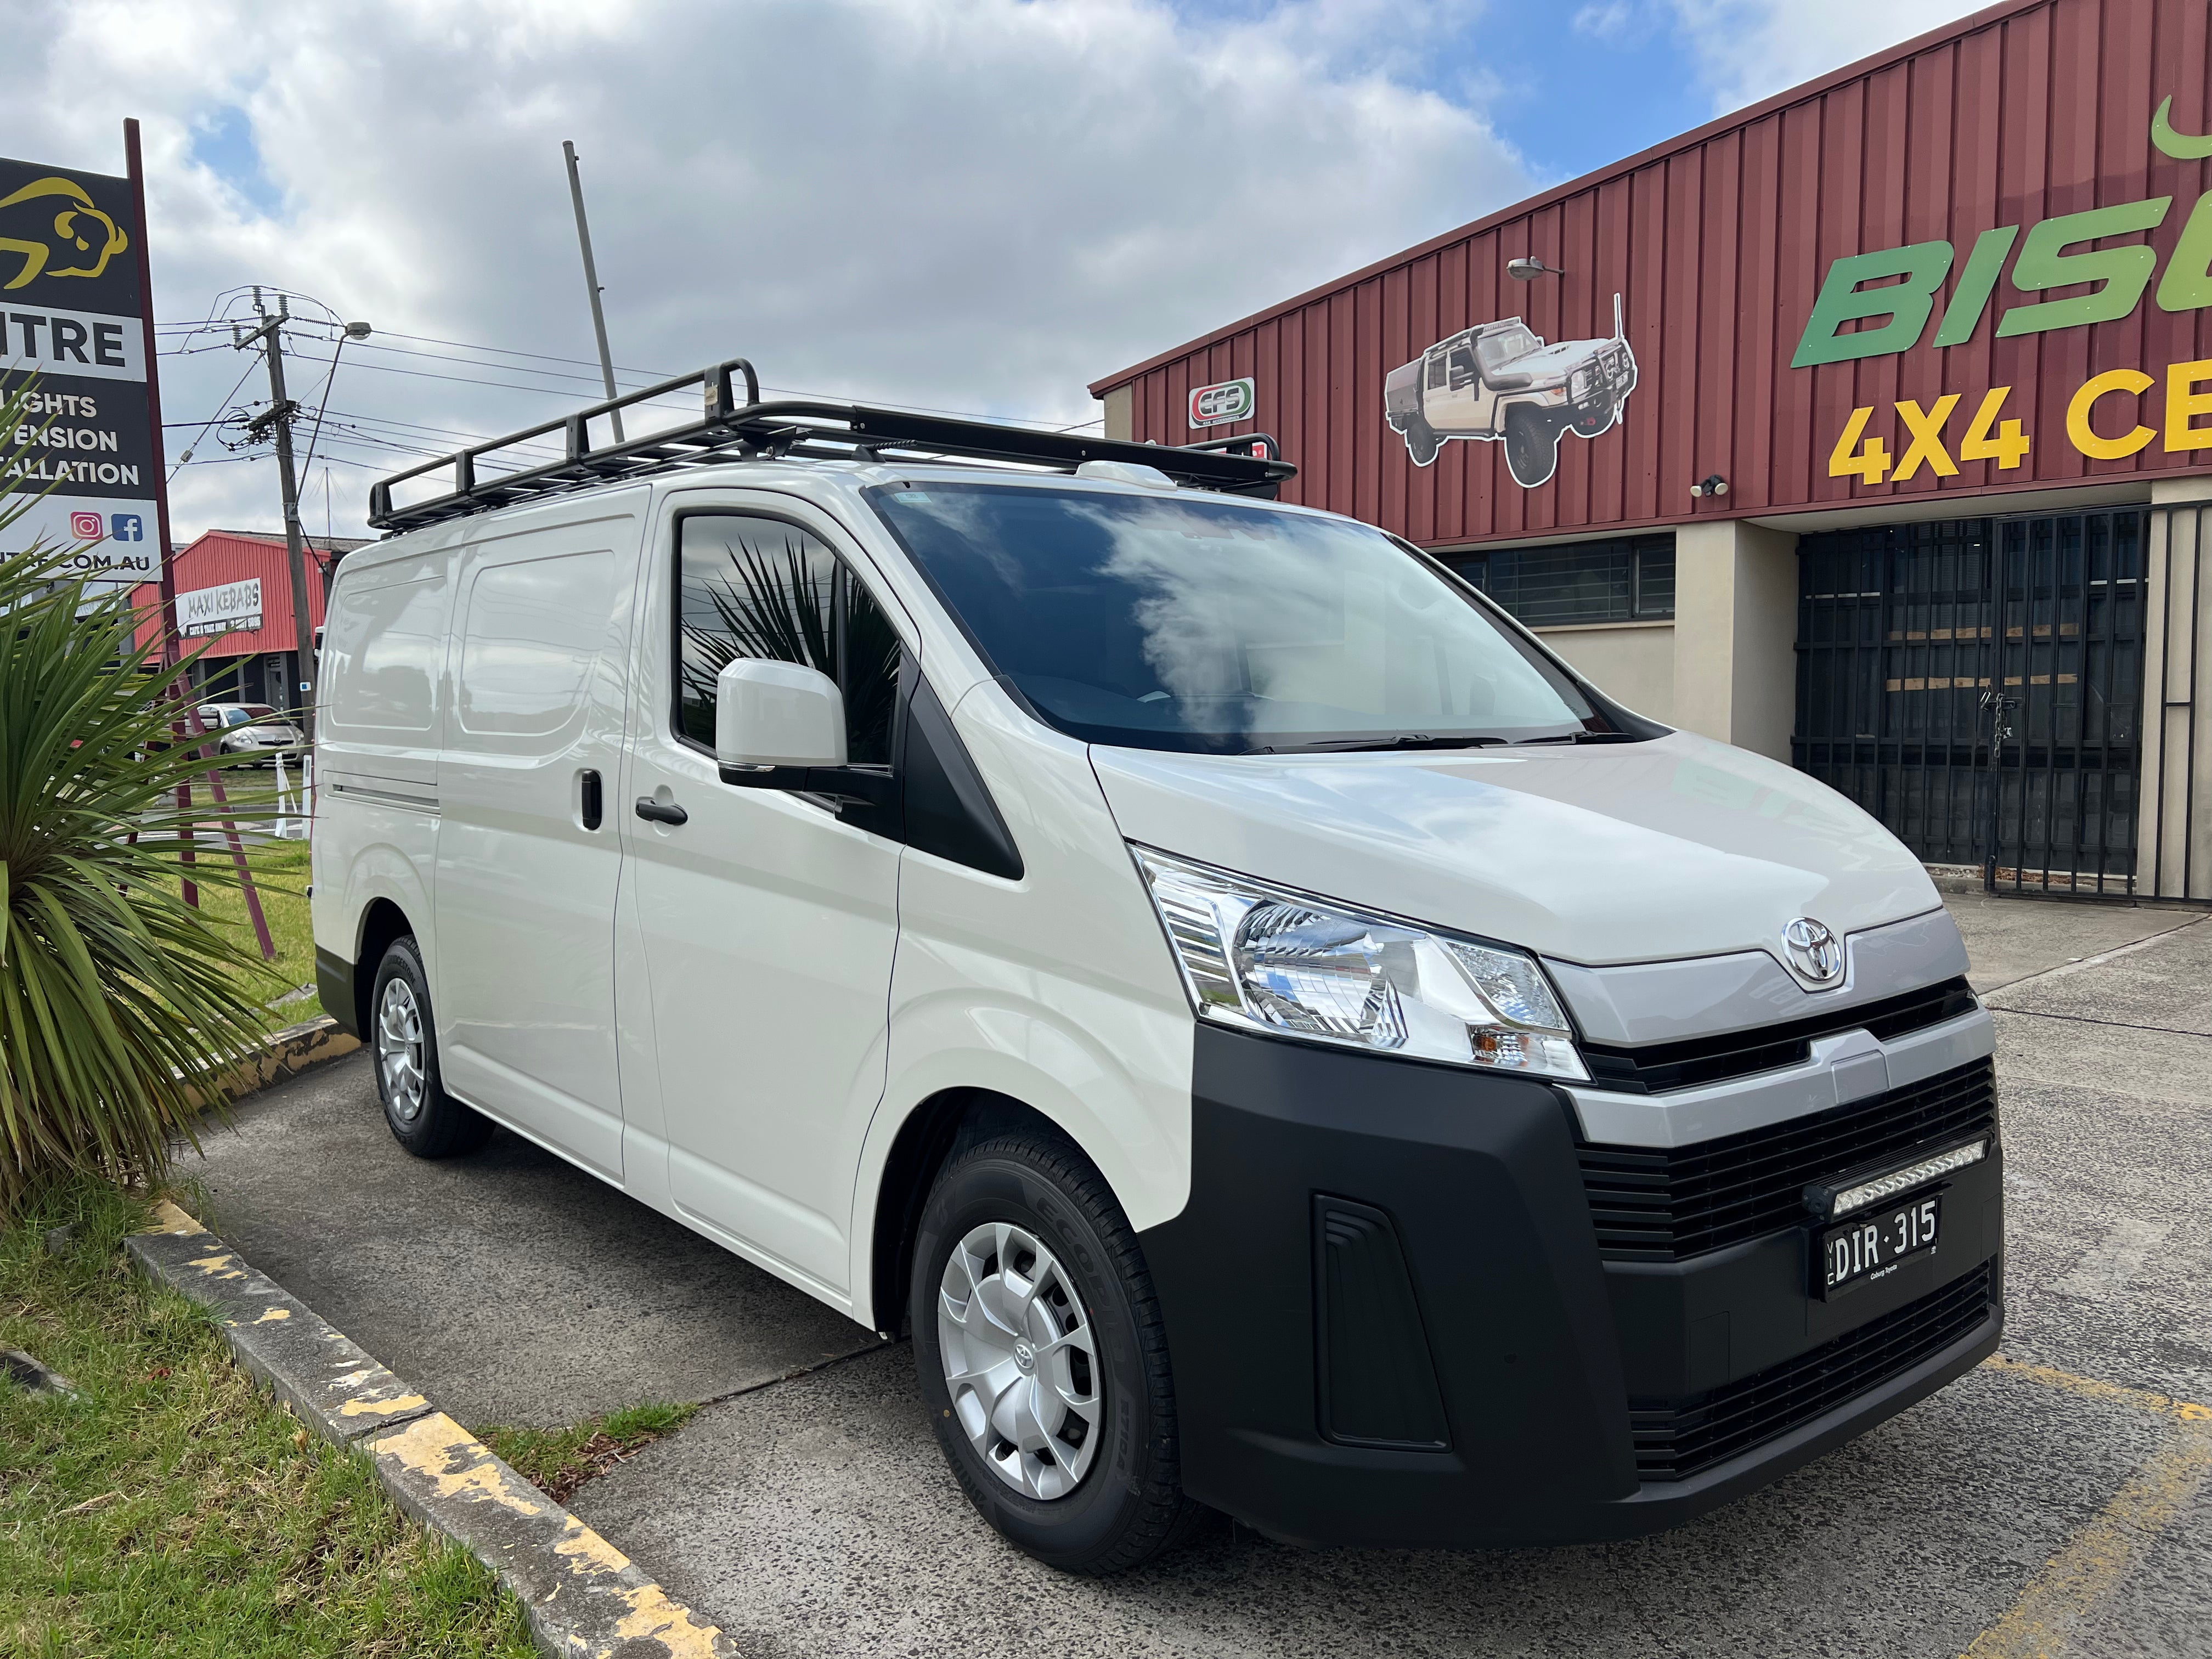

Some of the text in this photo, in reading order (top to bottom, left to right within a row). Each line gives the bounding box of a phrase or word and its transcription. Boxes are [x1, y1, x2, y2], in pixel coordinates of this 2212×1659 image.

[1200, 387, 1240, 414] EFS
[0, 425, 117, 452] ENSION
[1829, 359, 2212, 486] 4X4 CE
[188, 583, 258, 618] MAXI KEBABS
[1826, 1241, 1835, 1286] VIC
